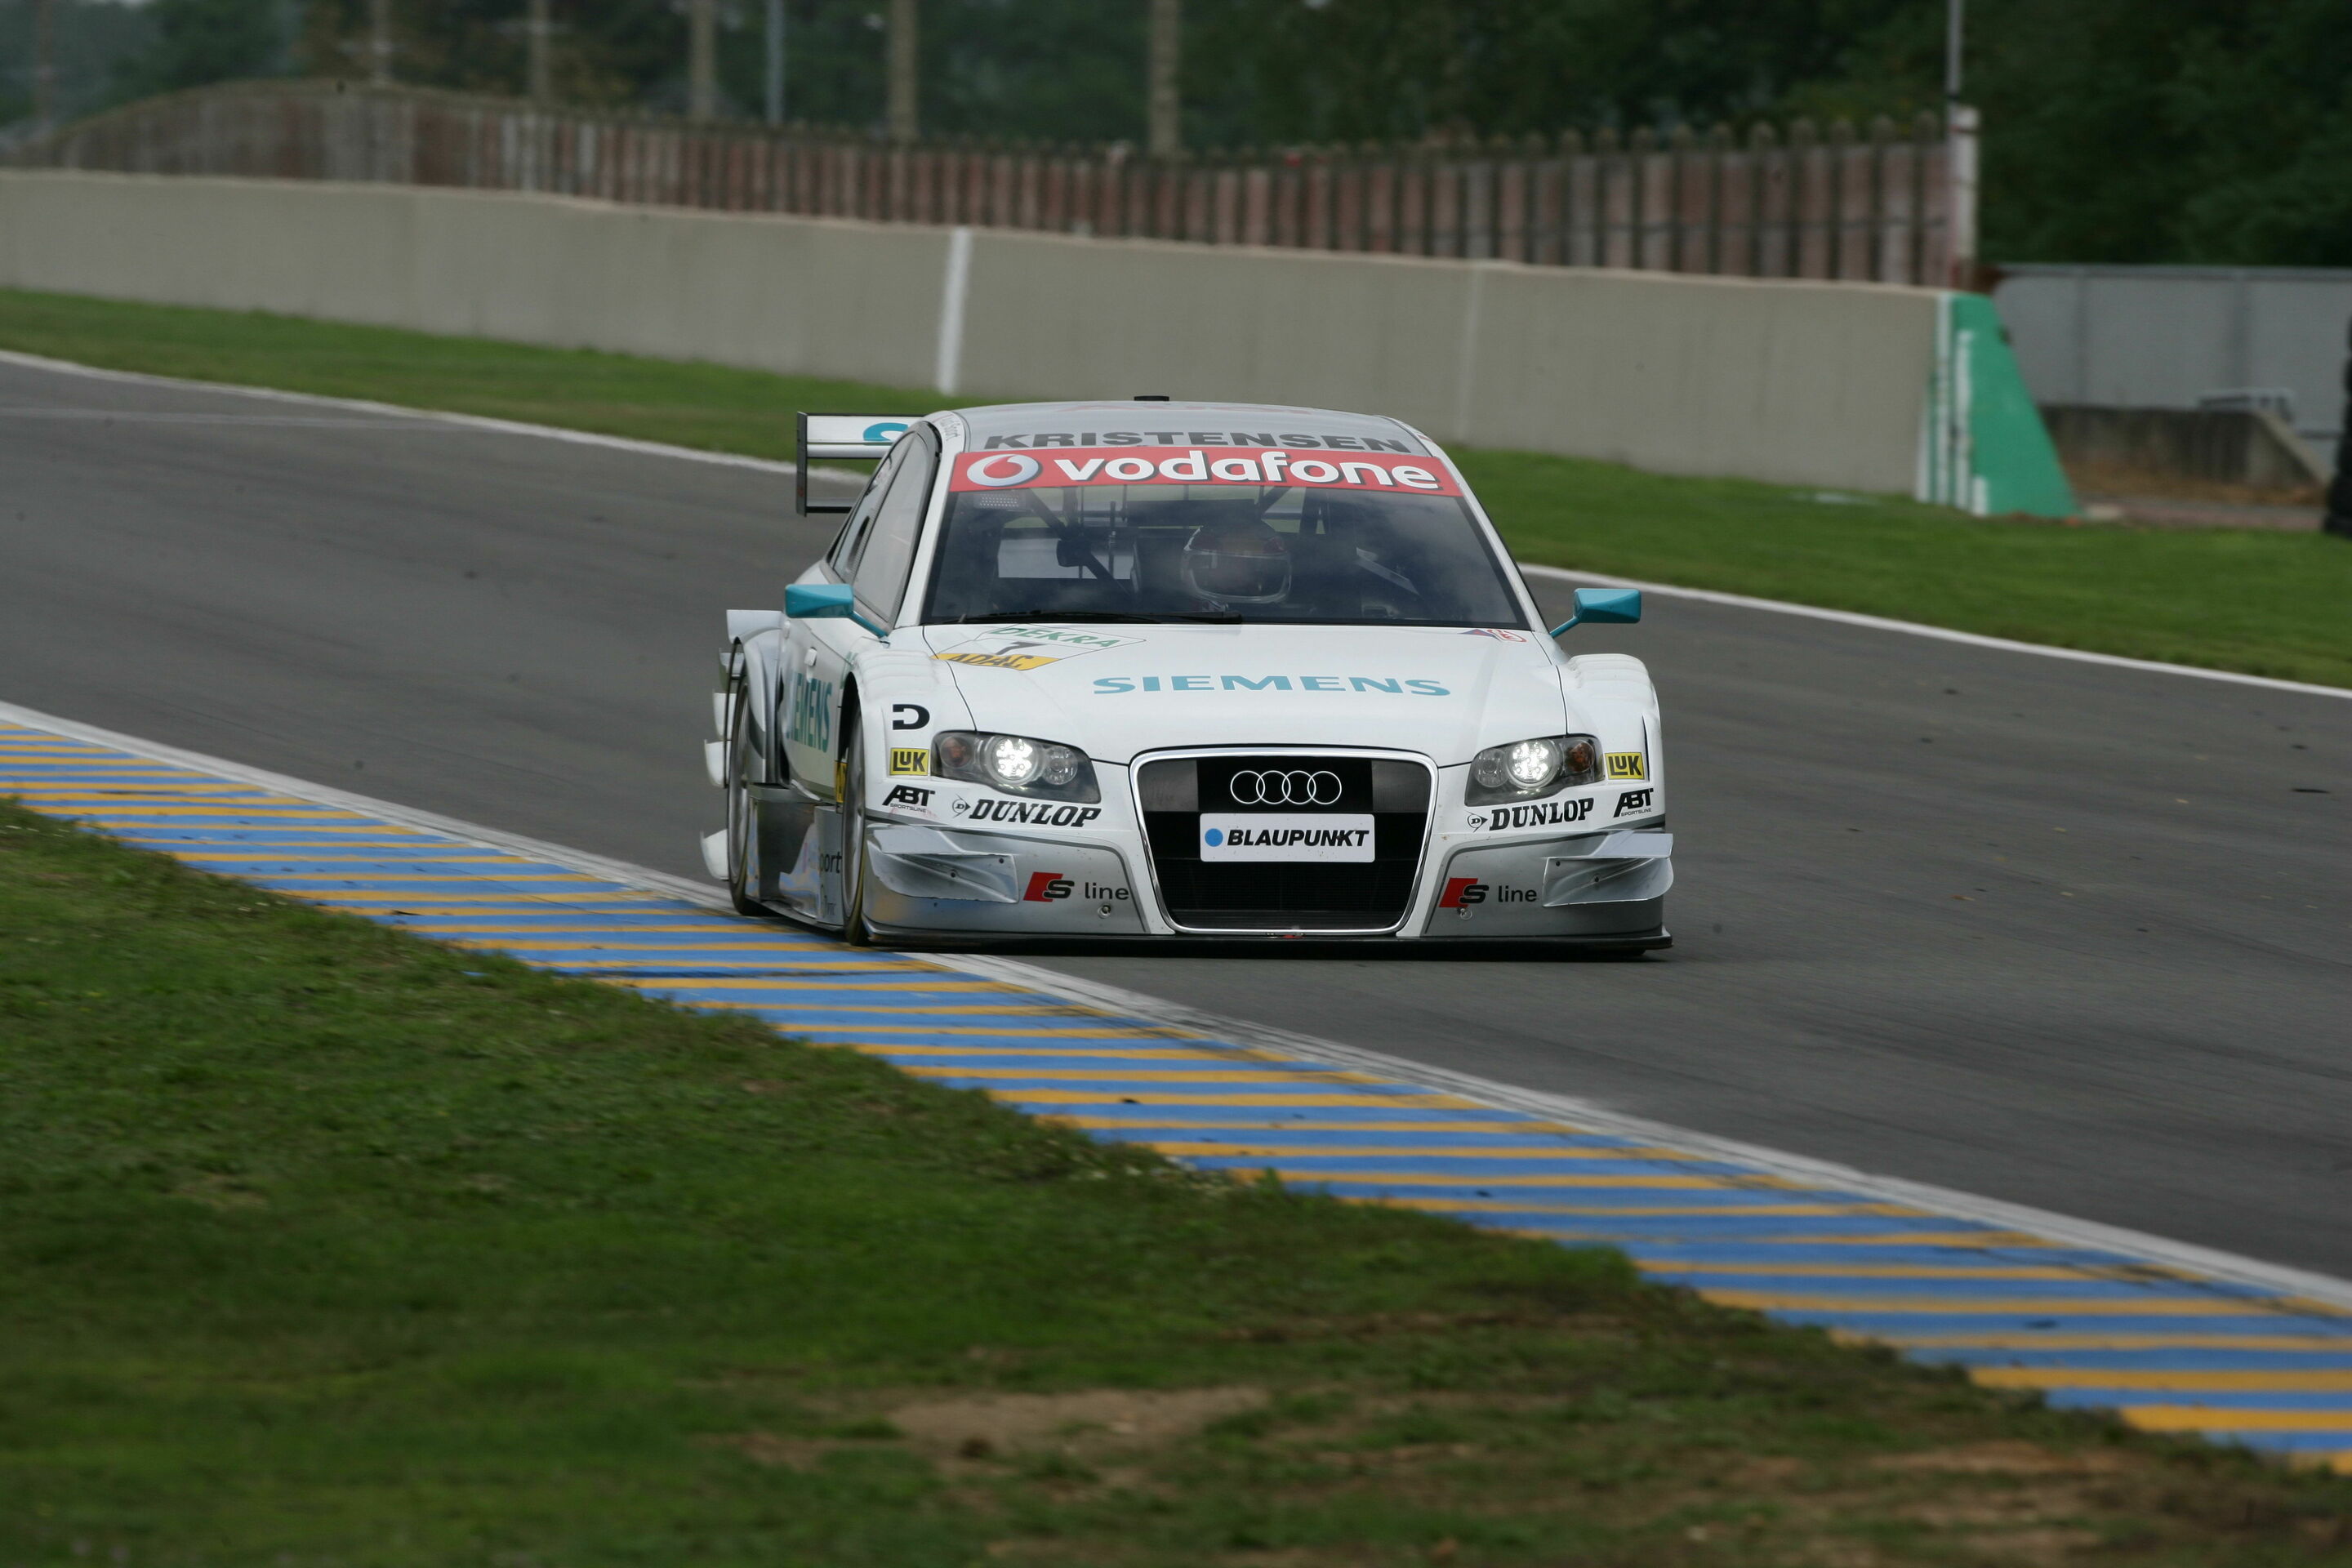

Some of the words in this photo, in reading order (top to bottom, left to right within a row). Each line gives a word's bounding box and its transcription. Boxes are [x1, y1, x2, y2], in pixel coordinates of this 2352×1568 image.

[984, 431, 1412, 454] KRISTENSEN
[1054, 450, 1440, 489] vodafone
[988, 627, 1121, 648] DEKRA
[947, 653, 1035, 669] ADAC
[1092, 675, 1451, 697] SIEMENS
[892, 703, 931, 731] D
[881, 784, 936, 807] ABT
[1613, 787, 1655, 818] ABT
[969, 799, 1102, 828] DUNLOP
[1489, 797, 1595, 831] DUNLOP
[1227, 829, 1370, 847] BLAUPUNKT
[1043, 880, 1076, 899] S
[1084, 881, 1129, 900] line
[1459, 884, 1490, 904] S
[1497, 884, 1538, 902] line
